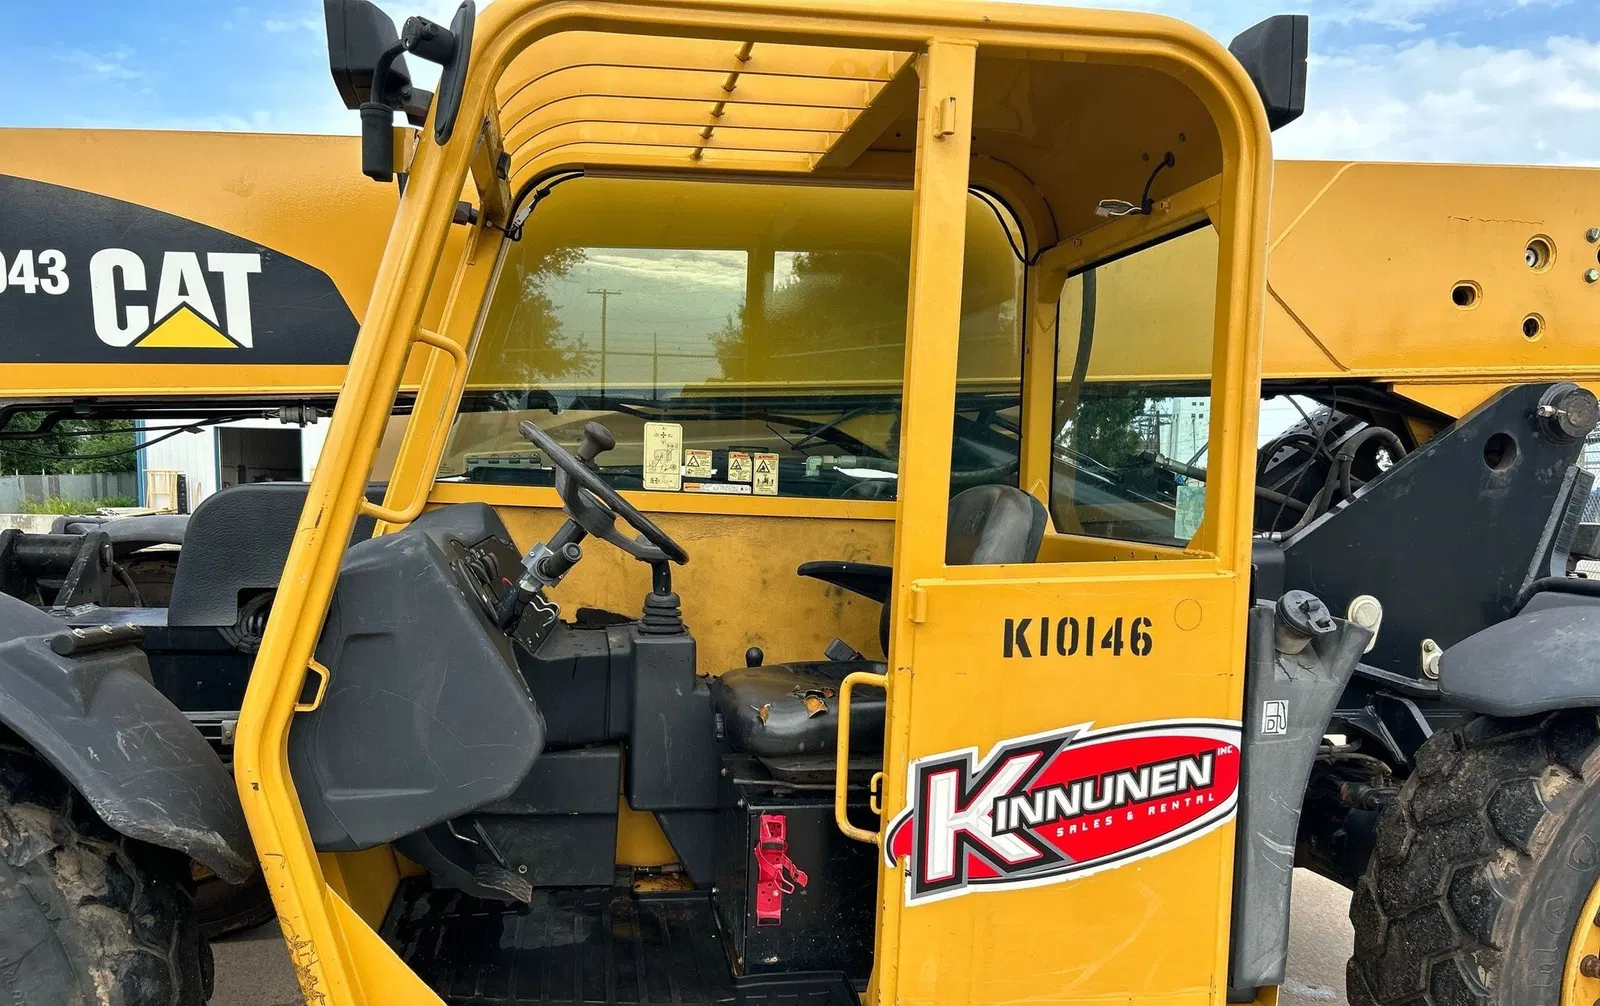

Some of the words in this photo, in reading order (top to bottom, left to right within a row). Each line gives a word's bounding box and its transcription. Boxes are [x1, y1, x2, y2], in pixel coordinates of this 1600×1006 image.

[0, 248, 70, 295] 43
[89, 248, 262, 349] CAT
[1003, 616, 1153, 658] K10146
[918, 742, 1214, 892] KINNUNEN
[1217, 745, 1233, 756] INC
[1056, 816, 1113, 838] SALES
[1126, 811, 1134, 820] &
[1147, 793, 1215, 816] RENTAL
